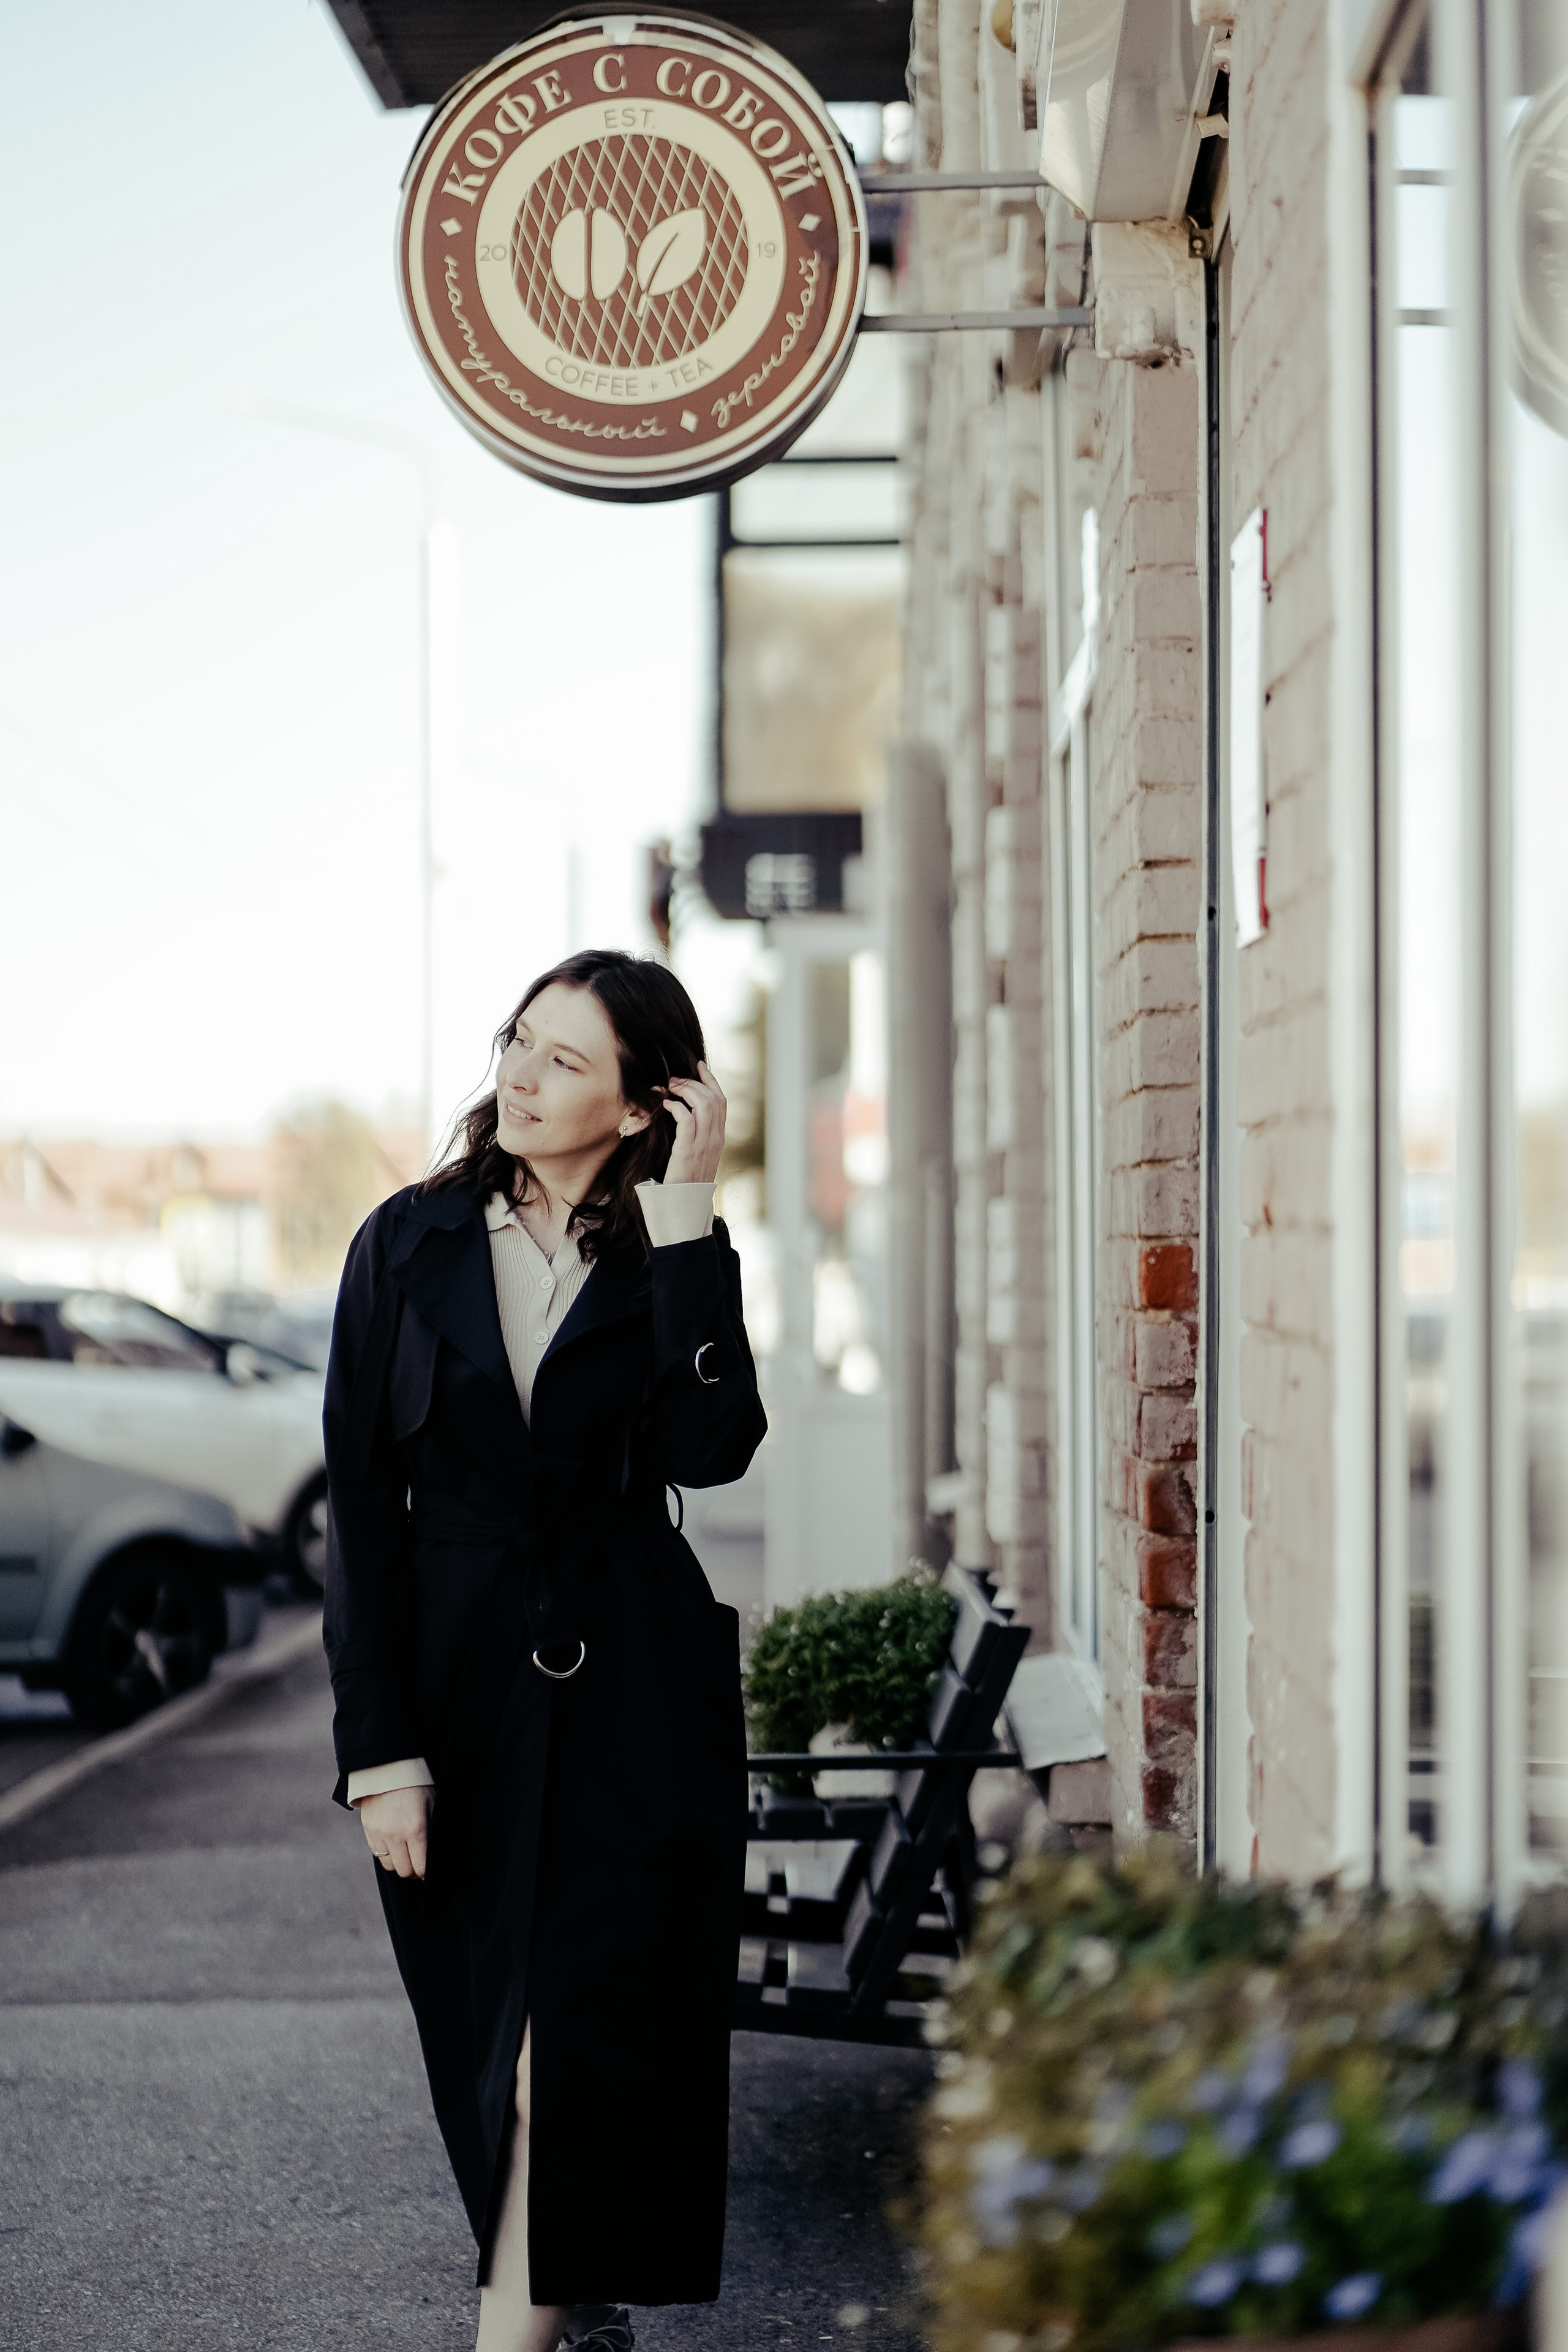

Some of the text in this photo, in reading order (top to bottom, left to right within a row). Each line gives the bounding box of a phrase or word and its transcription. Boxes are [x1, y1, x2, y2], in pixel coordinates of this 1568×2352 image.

[441, 53, 824, 206] КОФЕ С СОБОЙ
[604, 108, 655, 129] EST.
[479, 245, 507, 262] 20
[756, 242, 775, 258] 19
[444, 251, 821, 440] натуральный зерновой
[545, 357, 638, 397] COFFEE
[665, 358, 712, 388] TEA
